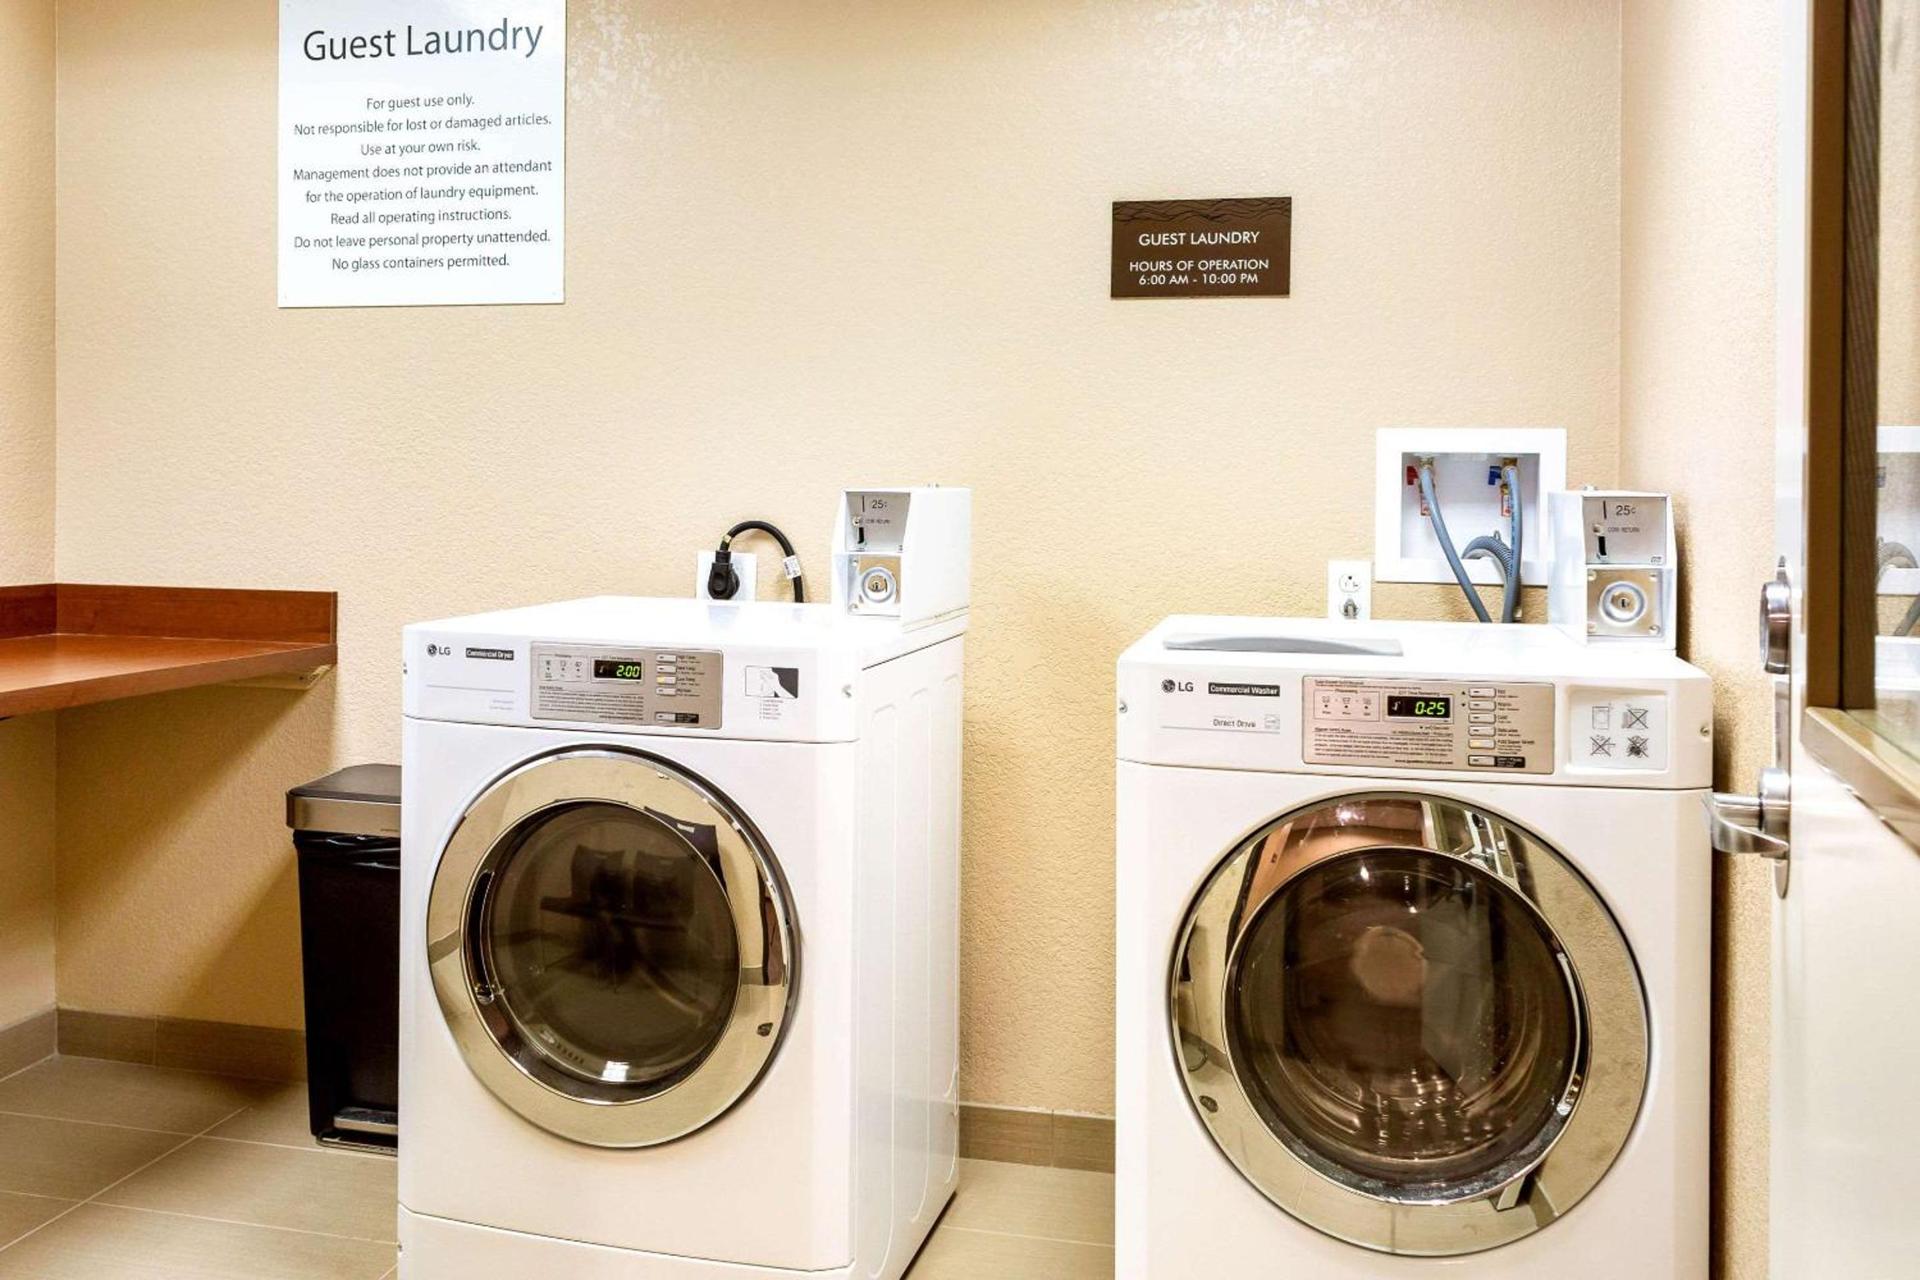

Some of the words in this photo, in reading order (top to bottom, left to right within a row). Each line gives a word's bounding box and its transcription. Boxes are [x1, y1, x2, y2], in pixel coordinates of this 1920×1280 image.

[303, 29, 396, 61] Guest
[407, 17, 544, 58] Laundry
[366, 97, 385, 110] For
[388, 96, 420, 112] guest
[424, 97, 444, 107] use
[447, 92, 475, 108] only.
[294, 123, 316, 136] Not
[318, 120, 384, 137] responsible
[387, 119, 403, 132] for
[405, 118, 427, 131] lost
[430, 120, 442, 130] or
[445, 115, 502, 131] damaged
[505, 113, 552, 127] articles.
[360, 144, 382, 156] Use
[384, 144, 396, 155] at
[398, 142, 426, 157] your
[428, 142, 454, 152] own
[457, 139, 481, 152] risk.
[293, 167, 370, 183] Management
[372, 165, 400, 178] does
[403, 165, 423, 177] not
[426, 162, 472, 178] provide
[474, 163, 489, 174] an
[492, 160, 552, 174] attendant
[305, 190, 322, 203] for
[324, 190, 344, 202] the
[346, 188, 403, 204] operation
[405, 187, 418, 200] of
[420, 186, 466, 201] laundry
[468, 184, 539, 200] equipment.
[330, 212, 360, 225] Read
[362, 211, 375, 224] all
[378, 210, 436, 226] operating
[438, 208, 512, 223] instructions.
[294, 236, 311, 249] Do
[313, 237, 333, 248] not
[336, 235, 366, 247] leave
[369, 233, 419, 249] personal
[421, 233, 474, 249] property
[476, 230, 551, 244] unattended.
[1138, 232, 1186, 246] GUEST
[1190, 231, 1260, 245] LAUNDRY
[332, 257, 349, 270] No
[351, 256, 380, 272] glass
[383, 255, 444, 269] containers
[447, 253, 510, 270] permitted.
[1129, 260, 1173, 272] HOURS
[1176, 260, 1194, 271] OF
[1197, 259, 1269, 271] OPERATION
[1138, 274, 1166, 285] 6:00
[1169, 274, 1189, 285] AM
[1203, 273, 1237, 284] 10:00
[1240, 273, 1259, 284] PM
